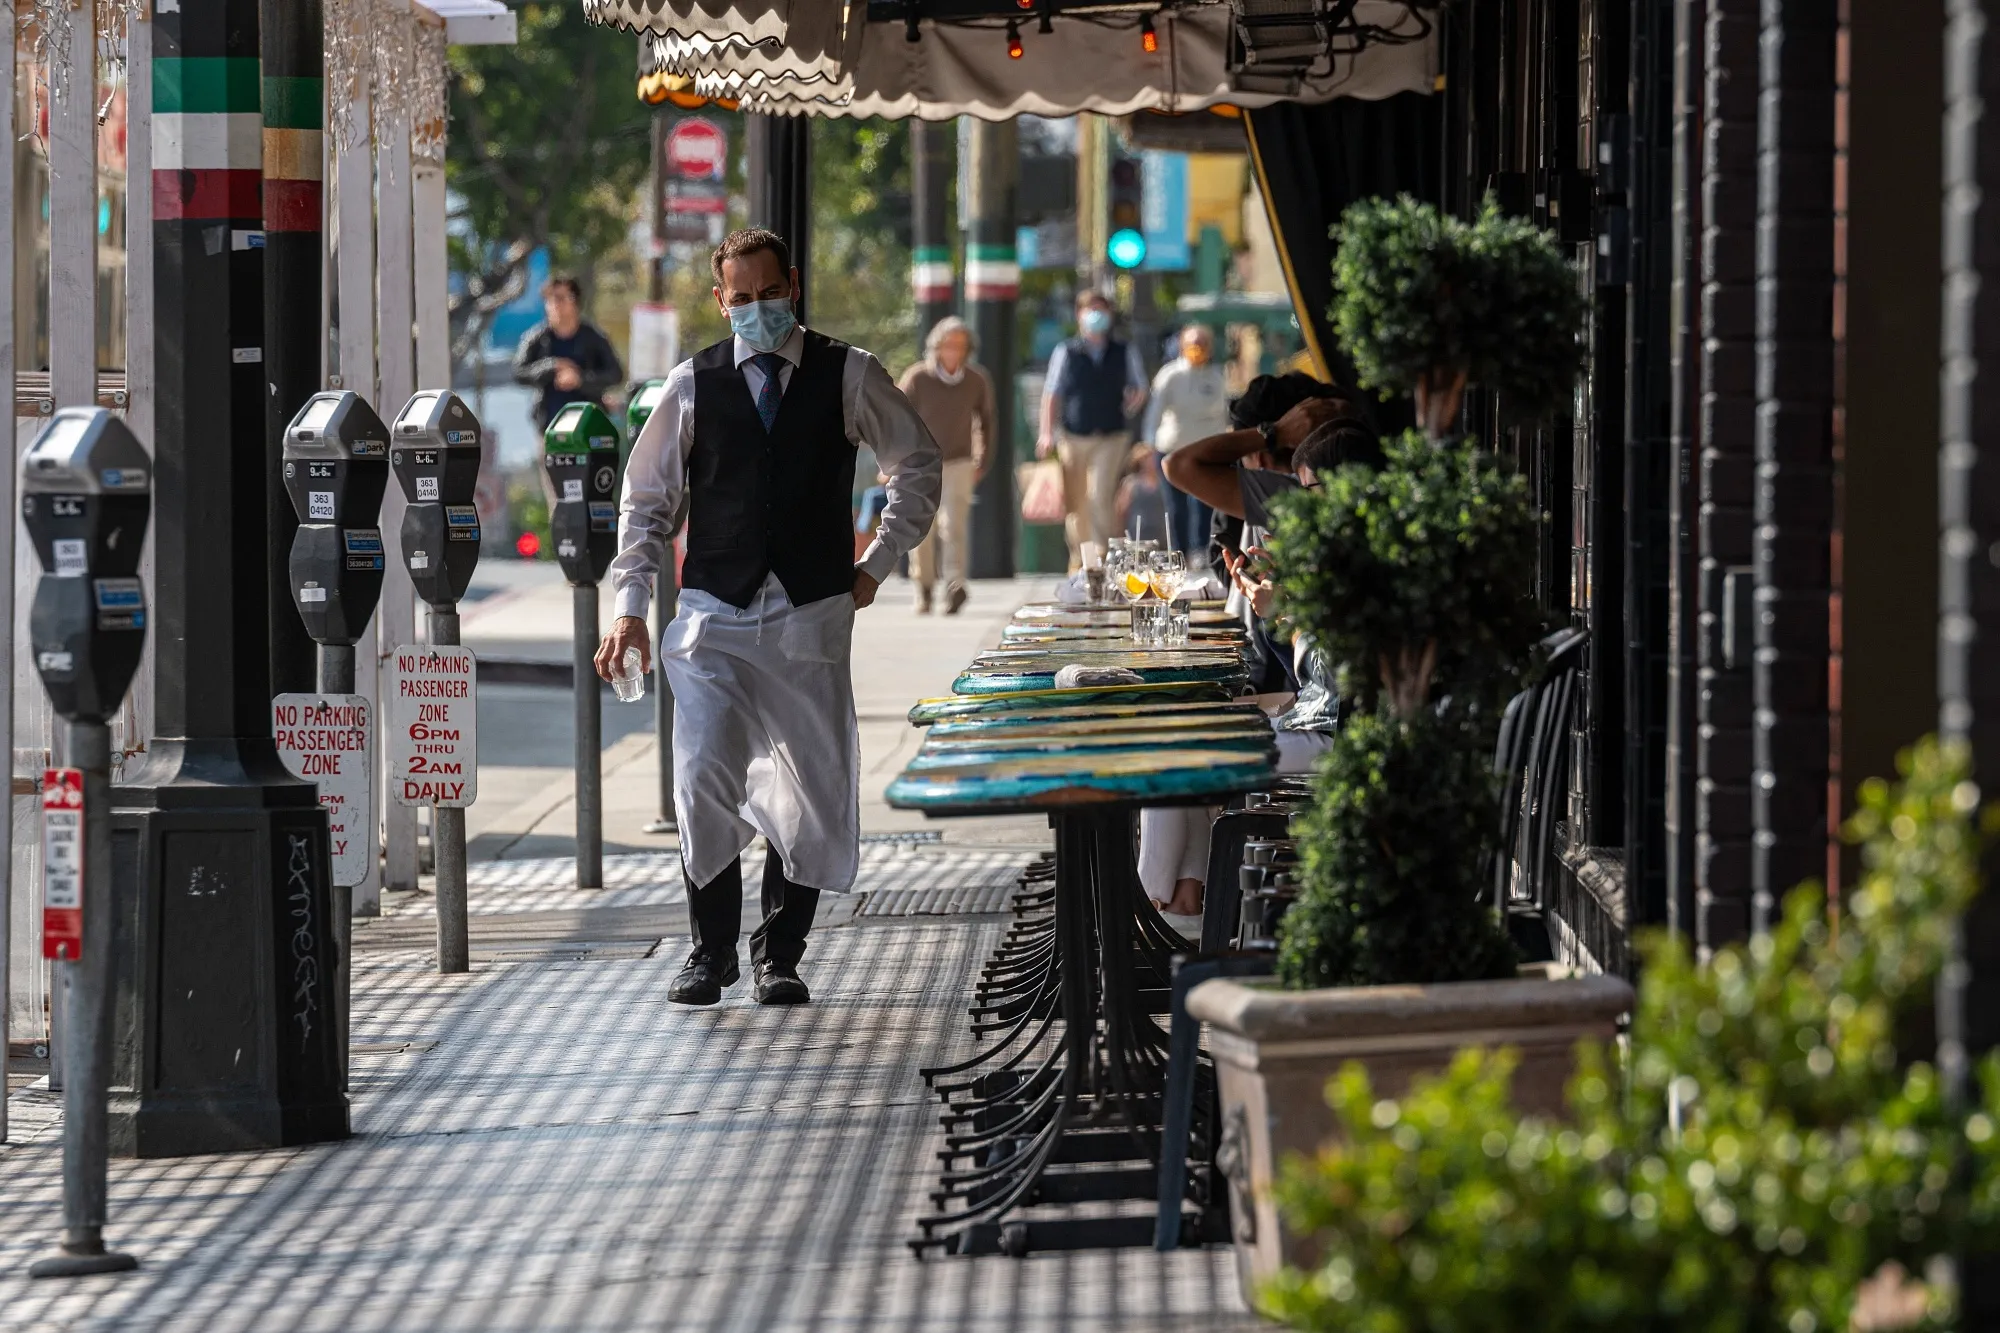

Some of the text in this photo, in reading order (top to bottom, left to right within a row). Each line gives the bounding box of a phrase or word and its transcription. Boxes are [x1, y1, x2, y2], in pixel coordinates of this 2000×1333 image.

[450, 432, 475, 444] SFpark
[314, 494, 329, 504] 363
[418, 489, 438, 498] 04140
[310, 505, 333, 516] 04120
[399, 655, 469, 674] NO PARKING
[400, 680, 468, 698] PASSENGER
[275, 705, 366, 727] NO PARKING
[419, 704, 449, 722] ZONE
[276, 730, 365, 751] PASSENGER
[409, 723, 460, 741] 6PM
[415, 744, 454, 754] THRU
[302, 755, 341, 775] ZONE
[408, 756, 462, 775] 2AM
[320, 796, 344, 804] PM
[404, 782, 465, 800] DAILY
